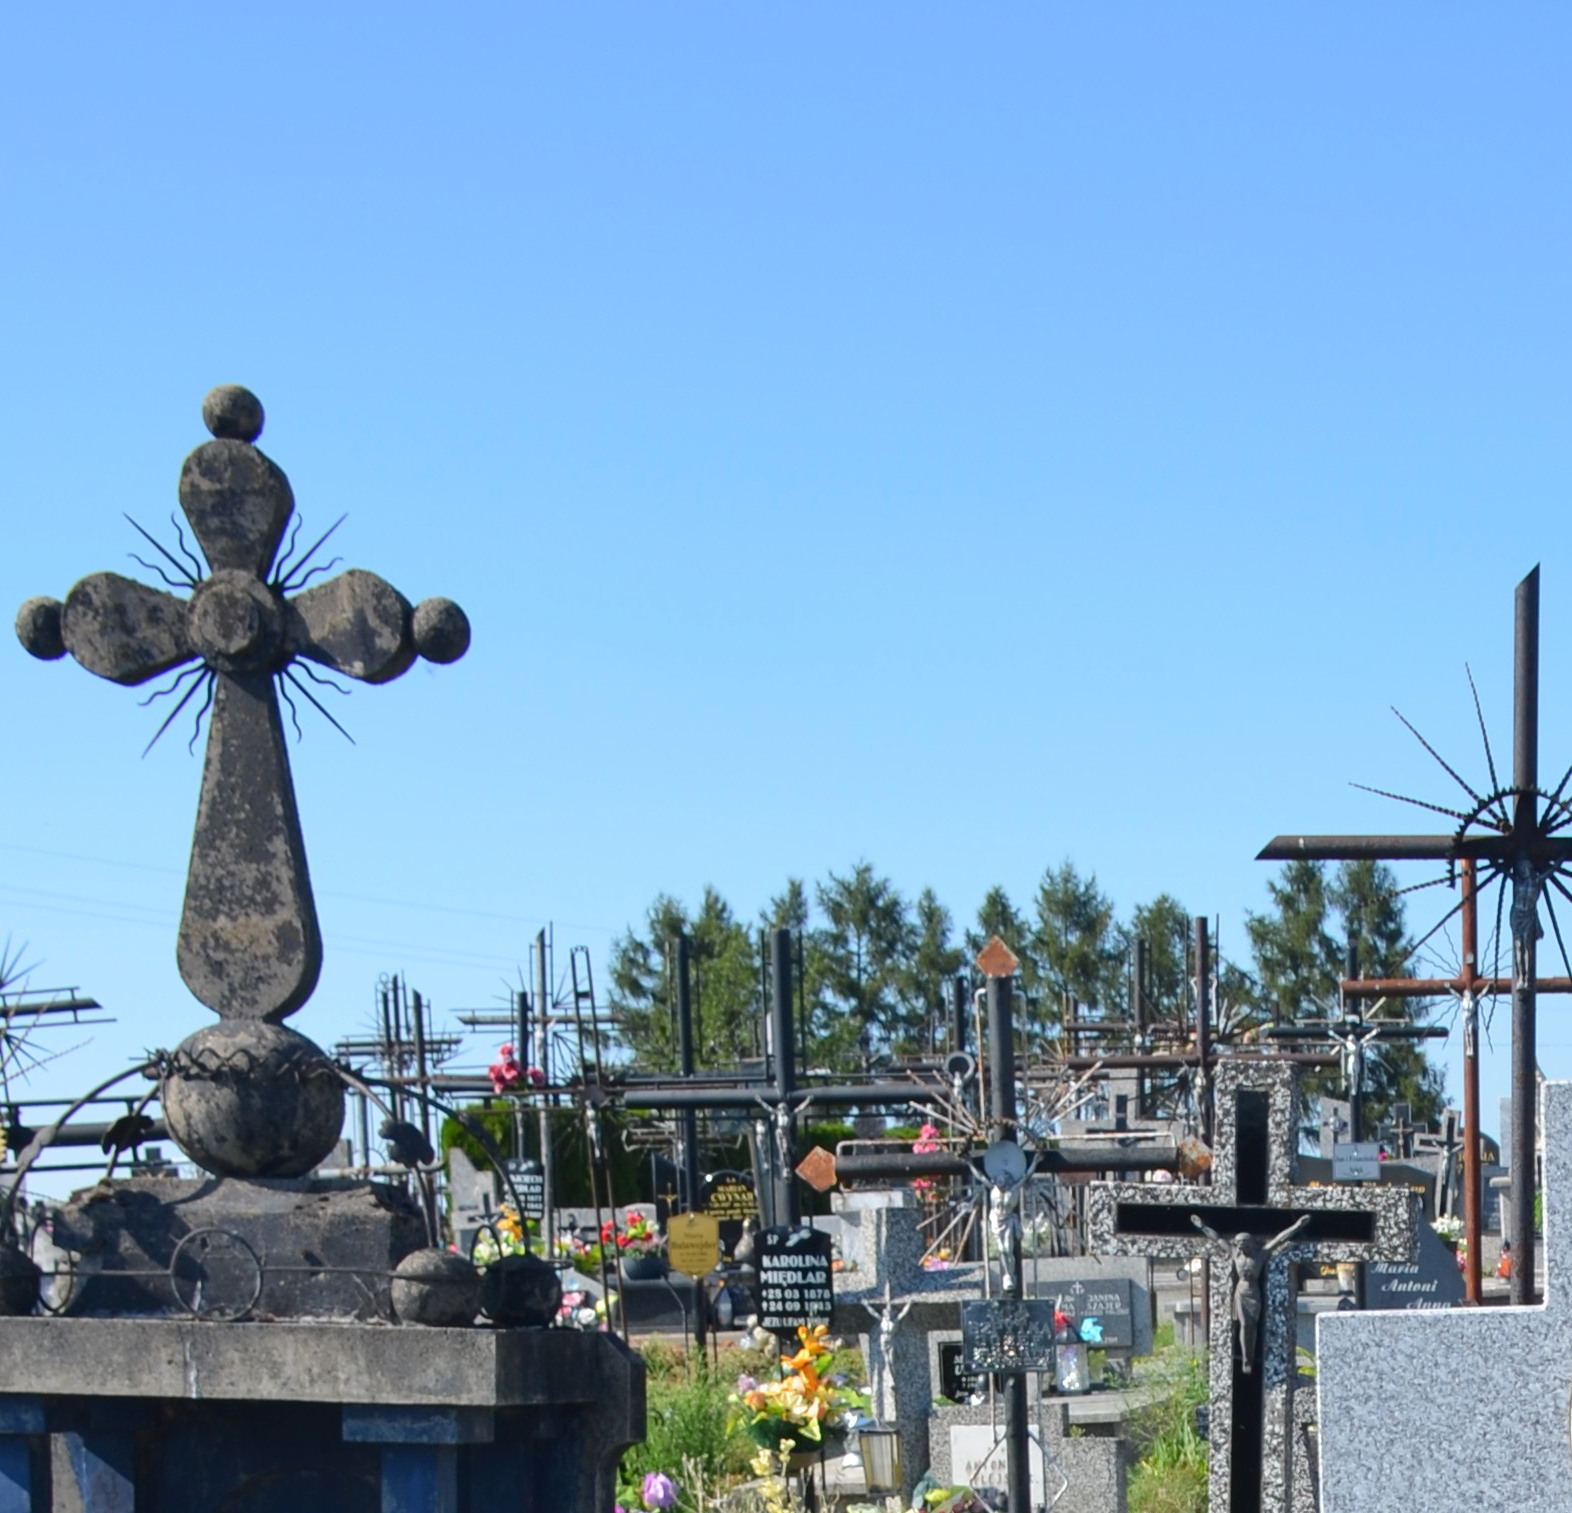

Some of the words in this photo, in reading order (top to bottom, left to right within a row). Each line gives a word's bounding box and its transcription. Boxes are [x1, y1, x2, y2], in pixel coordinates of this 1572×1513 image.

[761, 1254, 829, 1269] KAROLINA
[1371, 1262, 1420, 1275] Maria
[760, 1270, 828, 1288] MIĘDLAR
[1381, 1279, 1438, 1292] Antoni
